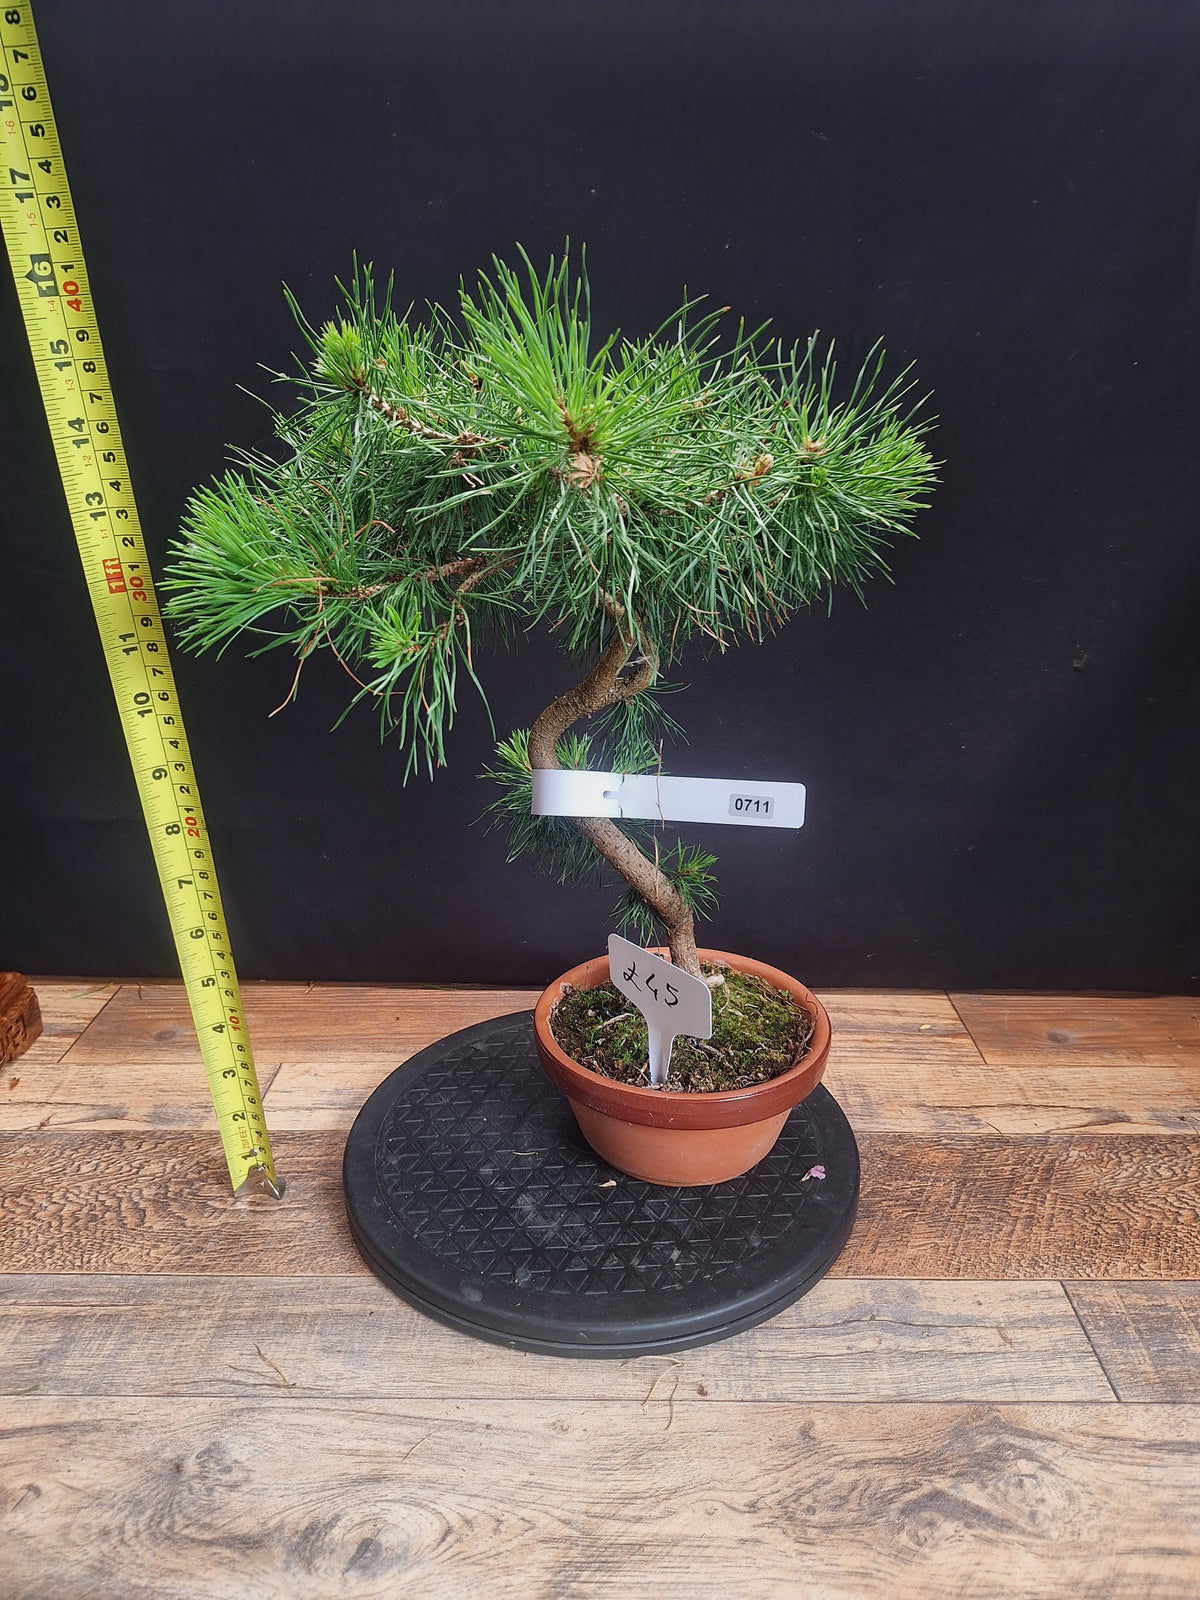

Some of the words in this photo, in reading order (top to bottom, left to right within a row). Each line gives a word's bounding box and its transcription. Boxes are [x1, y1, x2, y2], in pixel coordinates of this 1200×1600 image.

[5, 9, 20, 25] 8
[13, 49, 29, 63] 7
[22, 86, 37, 101] 6
[29, 123, 45, 138] 5
[38, 160, 52, 174] 4
[9, 168, 34, 203] 17
[46, 195, 61, 209] 3
[54, 230, 69, 243] 2
[61, 264, 74, 273] 1
[34, 261, 55, 291] 16
[63, 281, 82, 313] 40
[76, 329, 89, 342] 9
[49, 339, 73, 372] 15
[83, 361, 96, 373] 8
[89, 392, 103, 404] 7
[67, 417, 90, 448] 14
[96, 422, 109, 434] 6
[103, 452, 116, 463] 5
[109, 480, 121, 492] 4
[85, 491, 107, 521] 13
[116, 509, 128, 520] 3
[122, 537, 135, 547] 2
[129, 576, 147, 602] 30
[141, 617, 152, 627] 9
[119, 632, 138, 656] 11
[147, 643, 158, 652] 8
[152, 668, 164, 677] 7
[158, 692, 169, 701] 6
[134, 692, 153, 718] 10
[163, 716, 175, 725] 5
[169, 740, 180, 749] 4
[175, 763, 185, 772] 3
[152, 768, 168, 781] 9
[180, 785, 191, 794] 2
[735, 798, 769, 813] 0711
[165, 824, 181, 836] 8
[185, 816, 200, 838] 20
[194, 850, 204, 859] 9
[199, 871, 209, 880] 8
[177, 879, 193, 889] 7
[203, 892, 213, 900] 7
[208, 912, 218, 921] 6
[190, 928, 205, 940] 6
[213, 932, 222, 940] 5
[217, 952, 225, 960] 4
[221, 971, 230, 979] 3
[201, 977, 216, 988] 5
[623, 961, 679, 1007] £45
[225, 989, 234, 998] 2
[229, 1015, 241, 1031] 10
[212, 1024, 225, 1034] 4
[237, 1044, 245, 1052] 9
[240, 1062, 249, 1070] 8
[222, 1069, 236, 1079] 3
[248, 1096, 257, 1104] 6
[232, 1112, 246, 1122] 2
[252, 1113, 260, 1121] 5
[255, 1130, 263, 1138] 4
[259, 1146, 266, 1154] 3
